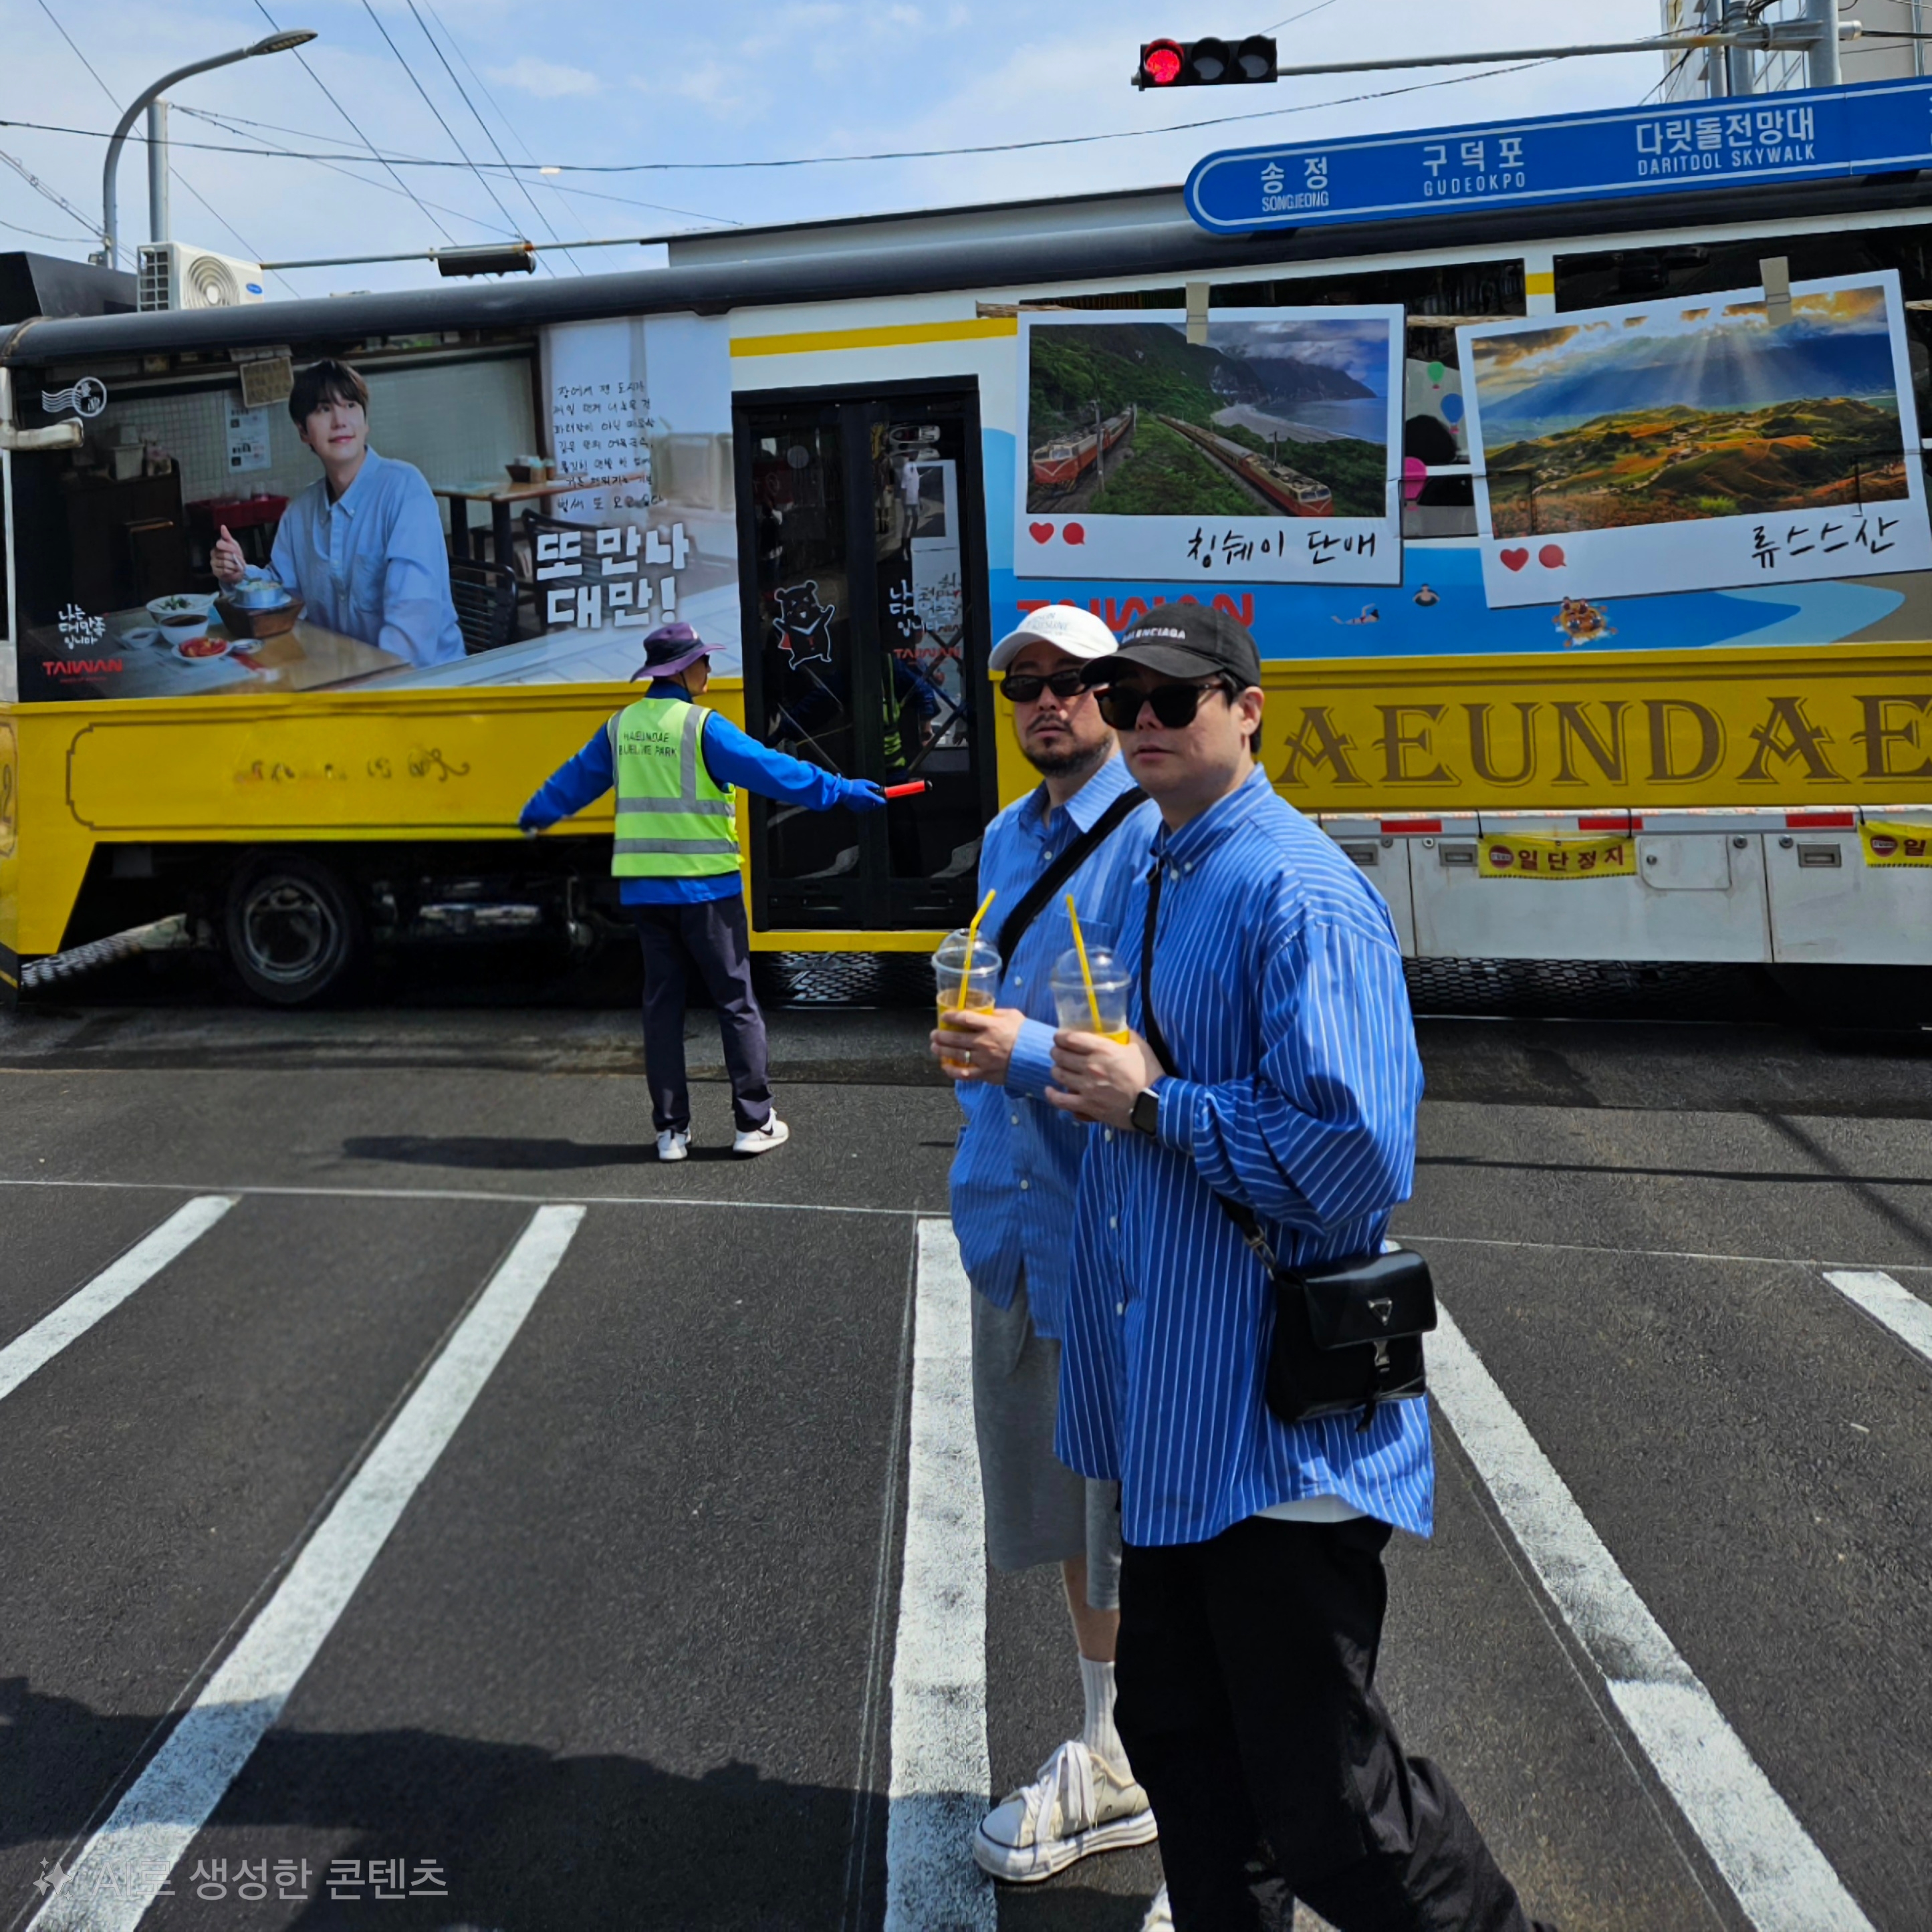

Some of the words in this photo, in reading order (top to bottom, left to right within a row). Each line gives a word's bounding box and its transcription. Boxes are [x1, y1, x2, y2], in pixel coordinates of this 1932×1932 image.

[1636, 106, 1814, 155] 다릿돌전망대
[1423, 138, 1526, 176] 구덕포
[1731, 143, 1816, 167] SKYWALK
[1260, 156, 1329, 194] 송정
[1423, 171, 1526, 197] GUDEOKPO
[1261, 191, 1329, 212] SONGJEONG
[537, 531, 583, 580] 또
[596, 522, 690, 576] 만나
[1187, 526, 1284, 568] 칭쉐이
[1751, 517, 1900, 569] 류스스산
[58, 603, 86, 622] 나는
[547, 576, 676, 628] 대만!
[42, 658, 123, 676] TAIWAN
[893, 647, 961, 660] TAIWAN
[1518, 844, 1624, 871] 일단정지
